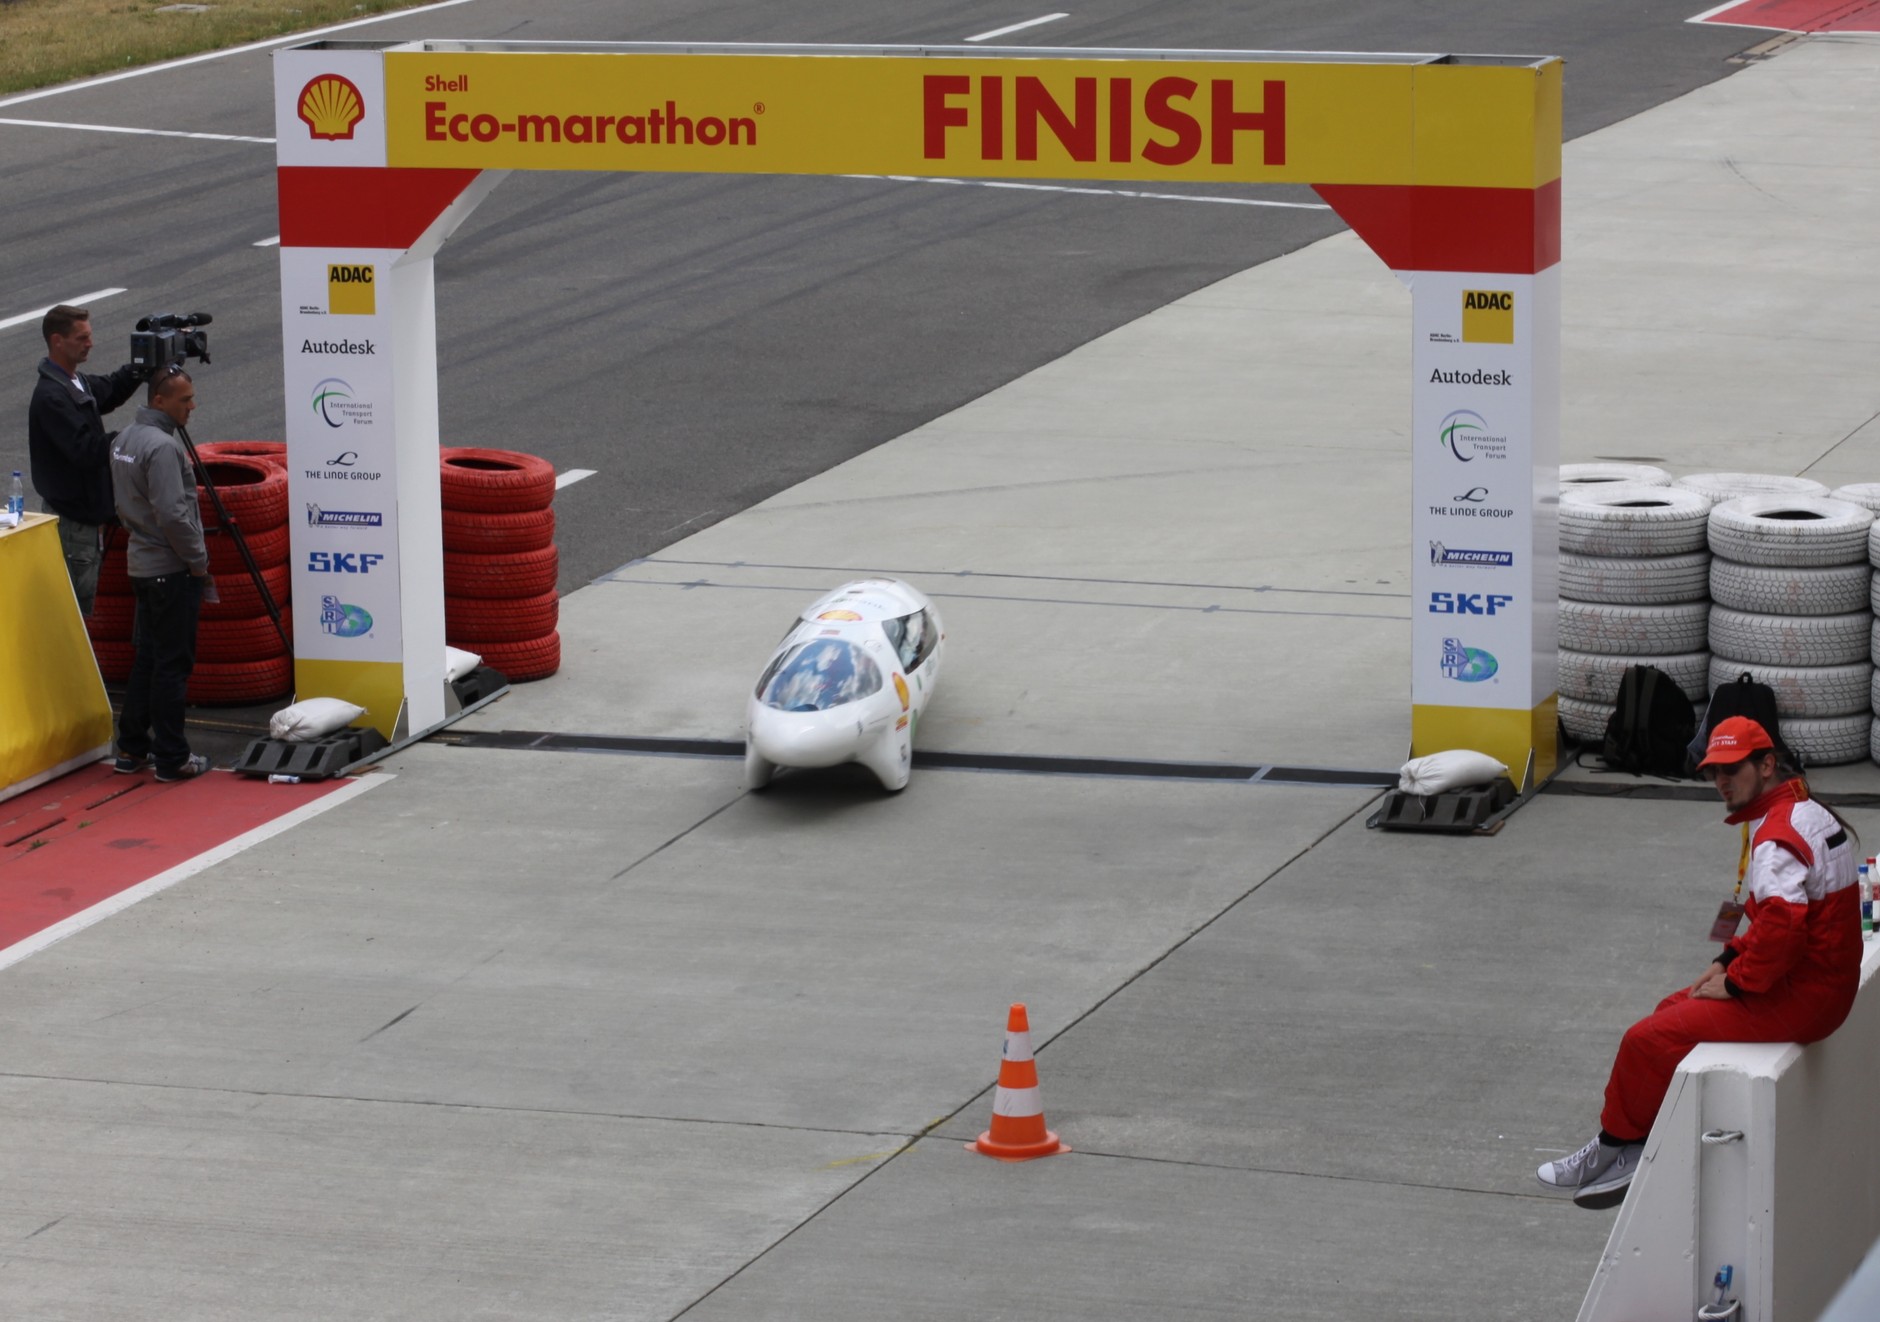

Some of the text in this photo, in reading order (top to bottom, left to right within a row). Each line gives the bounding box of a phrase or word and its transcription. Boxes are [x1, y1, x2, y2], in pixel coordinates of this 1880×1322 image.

[424, 74, 468, 92] Shell
[922, 74, 1286, 166] FINISH
[330, 266, 373, 283] ADAC
[1465, 292, 1511, 311] ADAC
[301, 339, 375, 354] Autodesk
[1430, 368, 1512, 386] Autodesk
[342, 410, 372, 418] Transport
[1460, 434, 1507, 442] International
[1473, 443, 1506, 452] Transport
[1485, 452, 1507, 460] Forum
[305, 470, 381, 481] THE LINDE GROUP
[322, 513, 380, 523] MICHELIN
[1429, 506, 1513, 519] THE LINDE GROUP
[308, 552, 384, 574] SKF
[1447, 552, 1510, 562] MICHELIN
[1429, 592, 1513, 616] SKF
